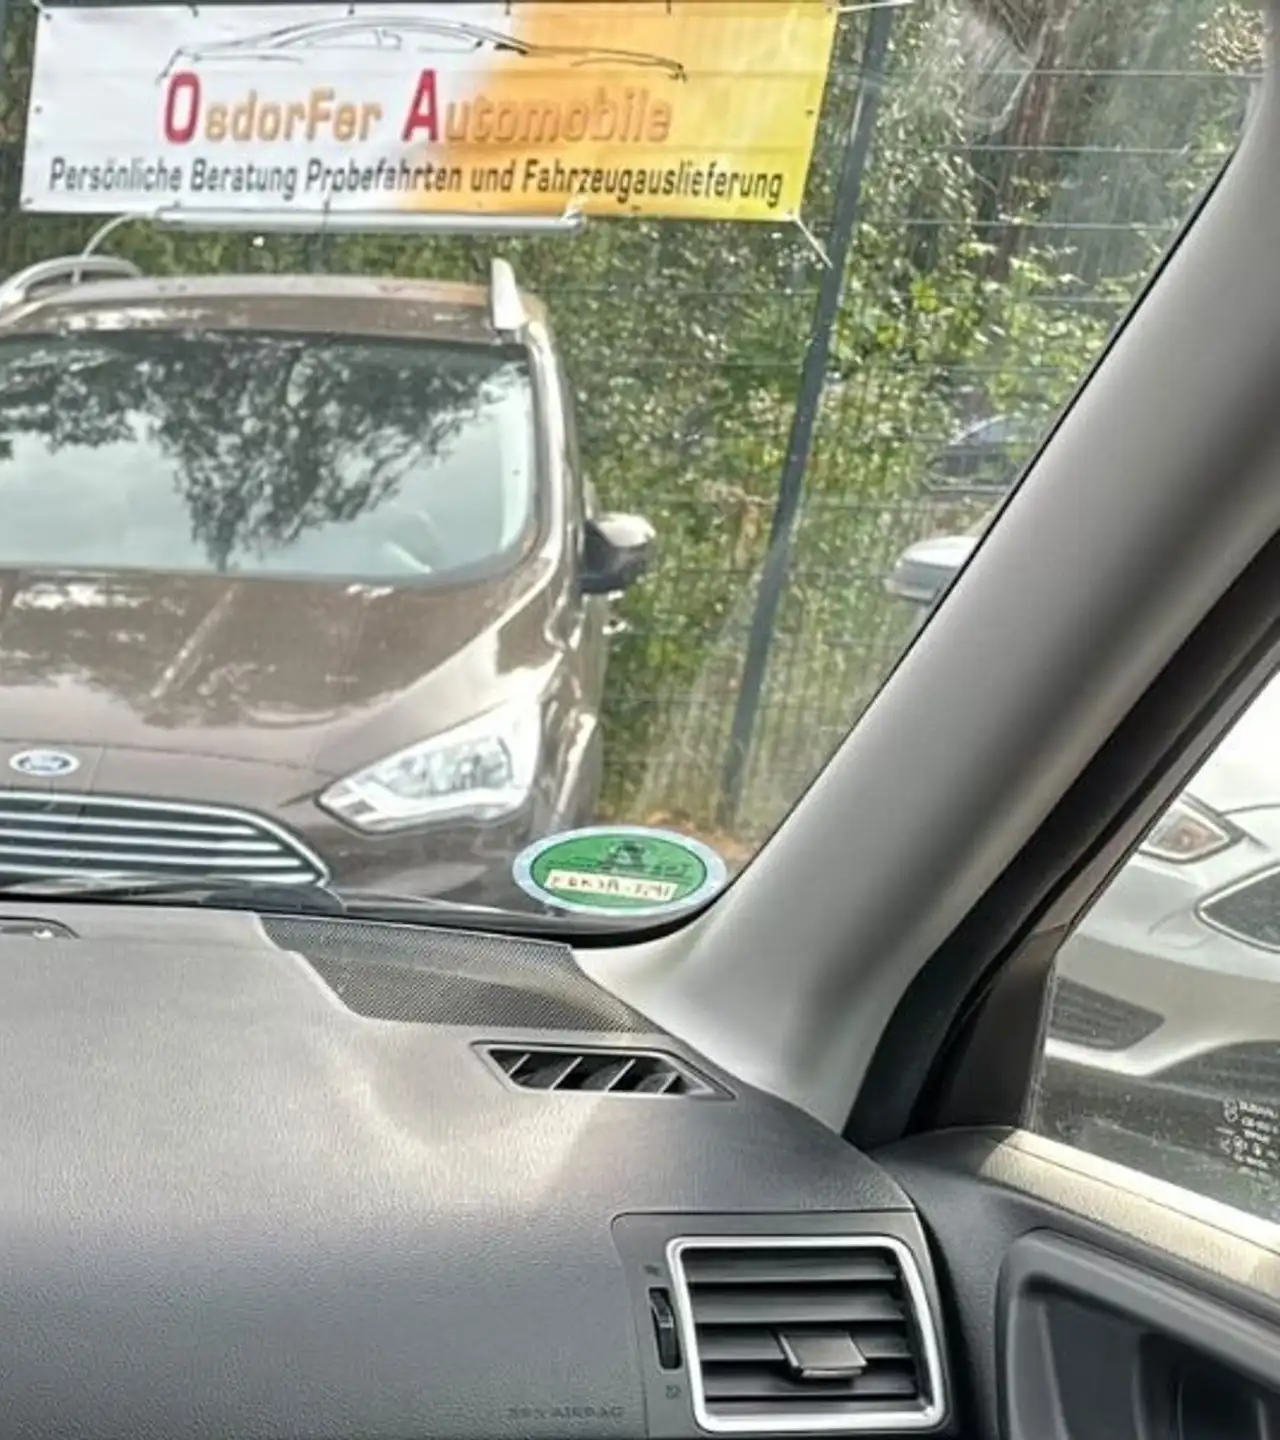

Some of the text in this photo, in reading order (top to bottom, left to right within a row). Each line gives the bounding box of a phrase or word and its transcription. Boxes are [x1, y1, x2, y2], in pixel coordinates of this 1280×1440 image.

[402, 68, 673, 143] Automobile
[49, 156, 784, 207] Persönliche Beratung Probefahrten und Fahrzeugauslieferung
